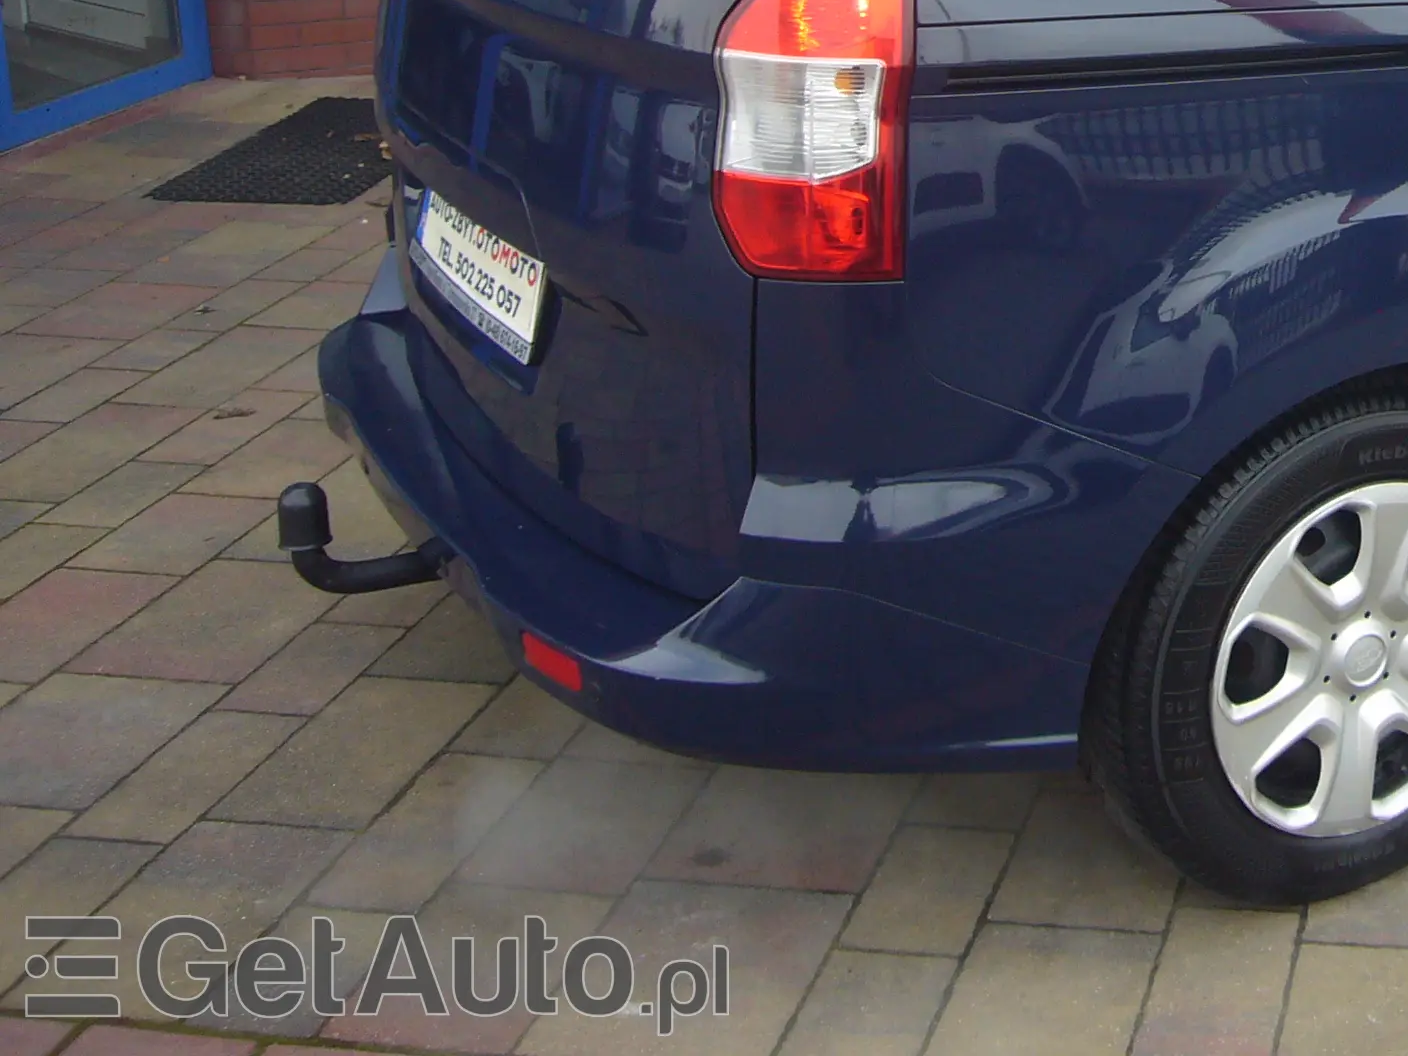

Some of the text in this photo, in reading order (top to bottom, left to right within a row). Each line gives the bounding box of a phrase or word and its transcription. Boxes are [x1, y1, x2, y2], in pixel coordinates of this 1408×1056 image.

[455, 251, 475, 285] 502
[476, 268, 496, 301] 225
[497, 284, 522, 318] 057
